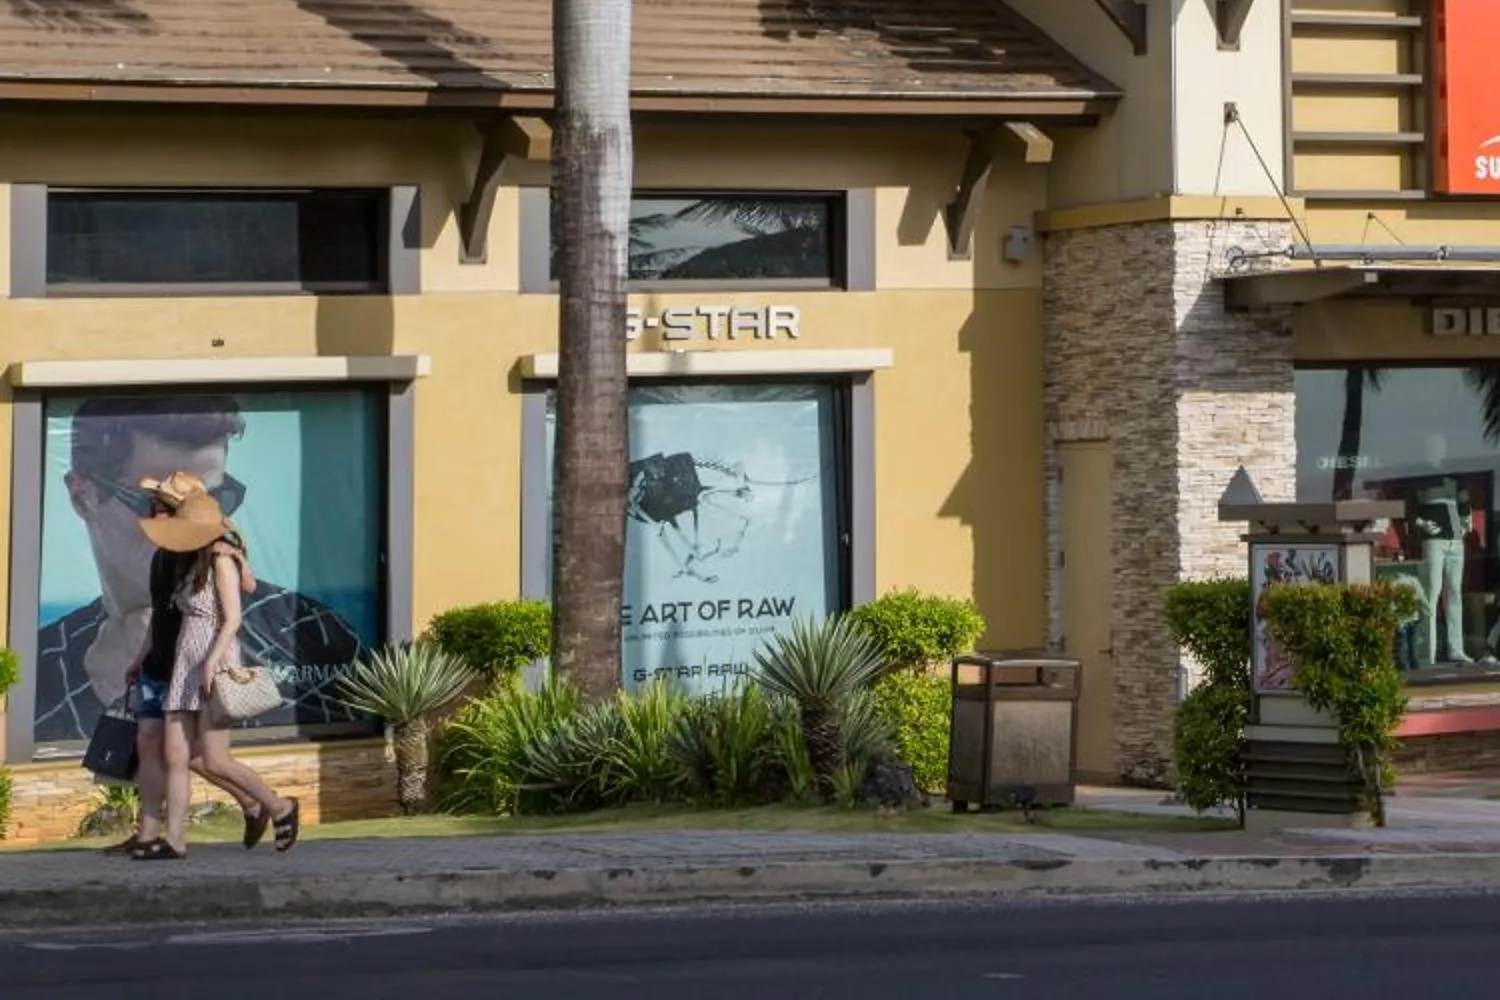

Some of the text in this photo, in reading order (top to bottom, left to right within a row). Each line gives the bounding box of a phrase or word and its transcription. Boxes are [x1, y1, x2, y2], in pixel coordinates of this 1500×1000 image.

[626, 304, 799, 340] G-STAR
[640, 601, 692, 625] ART
[698, 599, 730, 621] OF
[737, 595, 796, 619] RAW
[287, 662, 357, 682] ARMAN
[707, 661, 750, 677] RAW
